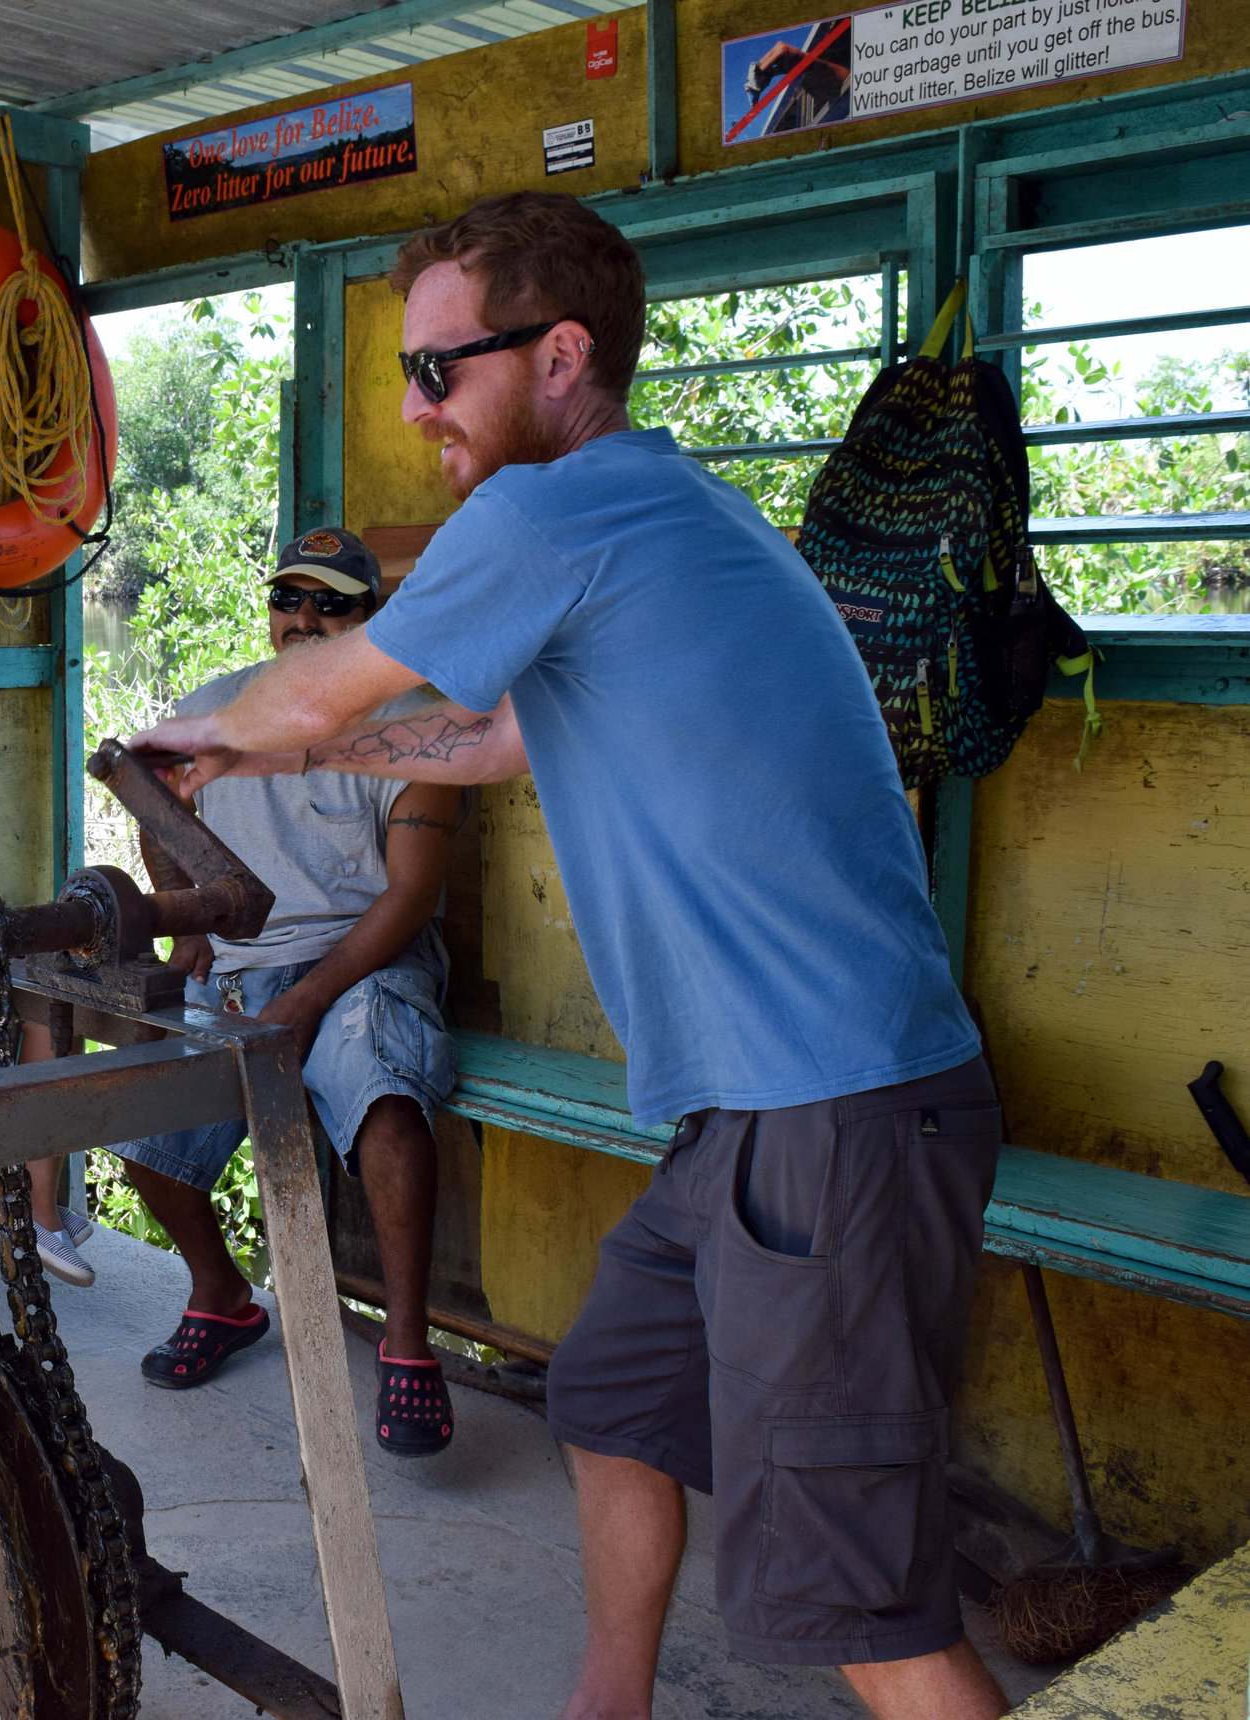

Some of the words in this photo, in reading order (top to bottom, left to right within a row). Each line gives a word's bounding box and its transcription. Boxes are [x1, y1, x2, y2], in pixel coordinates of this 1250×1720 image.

[855, 42, 884, 60] You
[890, 36, 918, 53] can
[924, 28, 945, 46] do
[950, 20, 987, 46] your
[992, 9, 1026, 37] part
[1032, 6, 1053, 26] by
[1056, 0, 1090, 23] just
[902, 0, 951, 29] KEEP
[853, 86, 914, 111] Without
[919, 80, 957, 100] litter,
[964, 68, 1015, 91] Belize
[1021, 58, 1048, 79] will
[1054, 45, 1109, 78] glitter!
[854, 67, 889, 91] your
[893, 53, 961, 83] garbage
[967, 40, 1001, 64] until
[1007, 37, 1038, 61] you
[1044, 26, 1072, 53] get
[1078, 19, 1102, 41] off
[1107, 16, 1135, 36] the
[1142, 8, 1180, 29] bus.
[189, 139, 226, 168] One
[231, 130, 269, 159] love
[272, 117, 305, 158] for
[310, 100, 380, 140] Belize.
[171, 184, 211, 212] Zero
[216, 172, 260, 202] litter
[262, 161, 295, 200] for
[300, 156, 336, 183] our
[338, 140, 413, 184] future.
